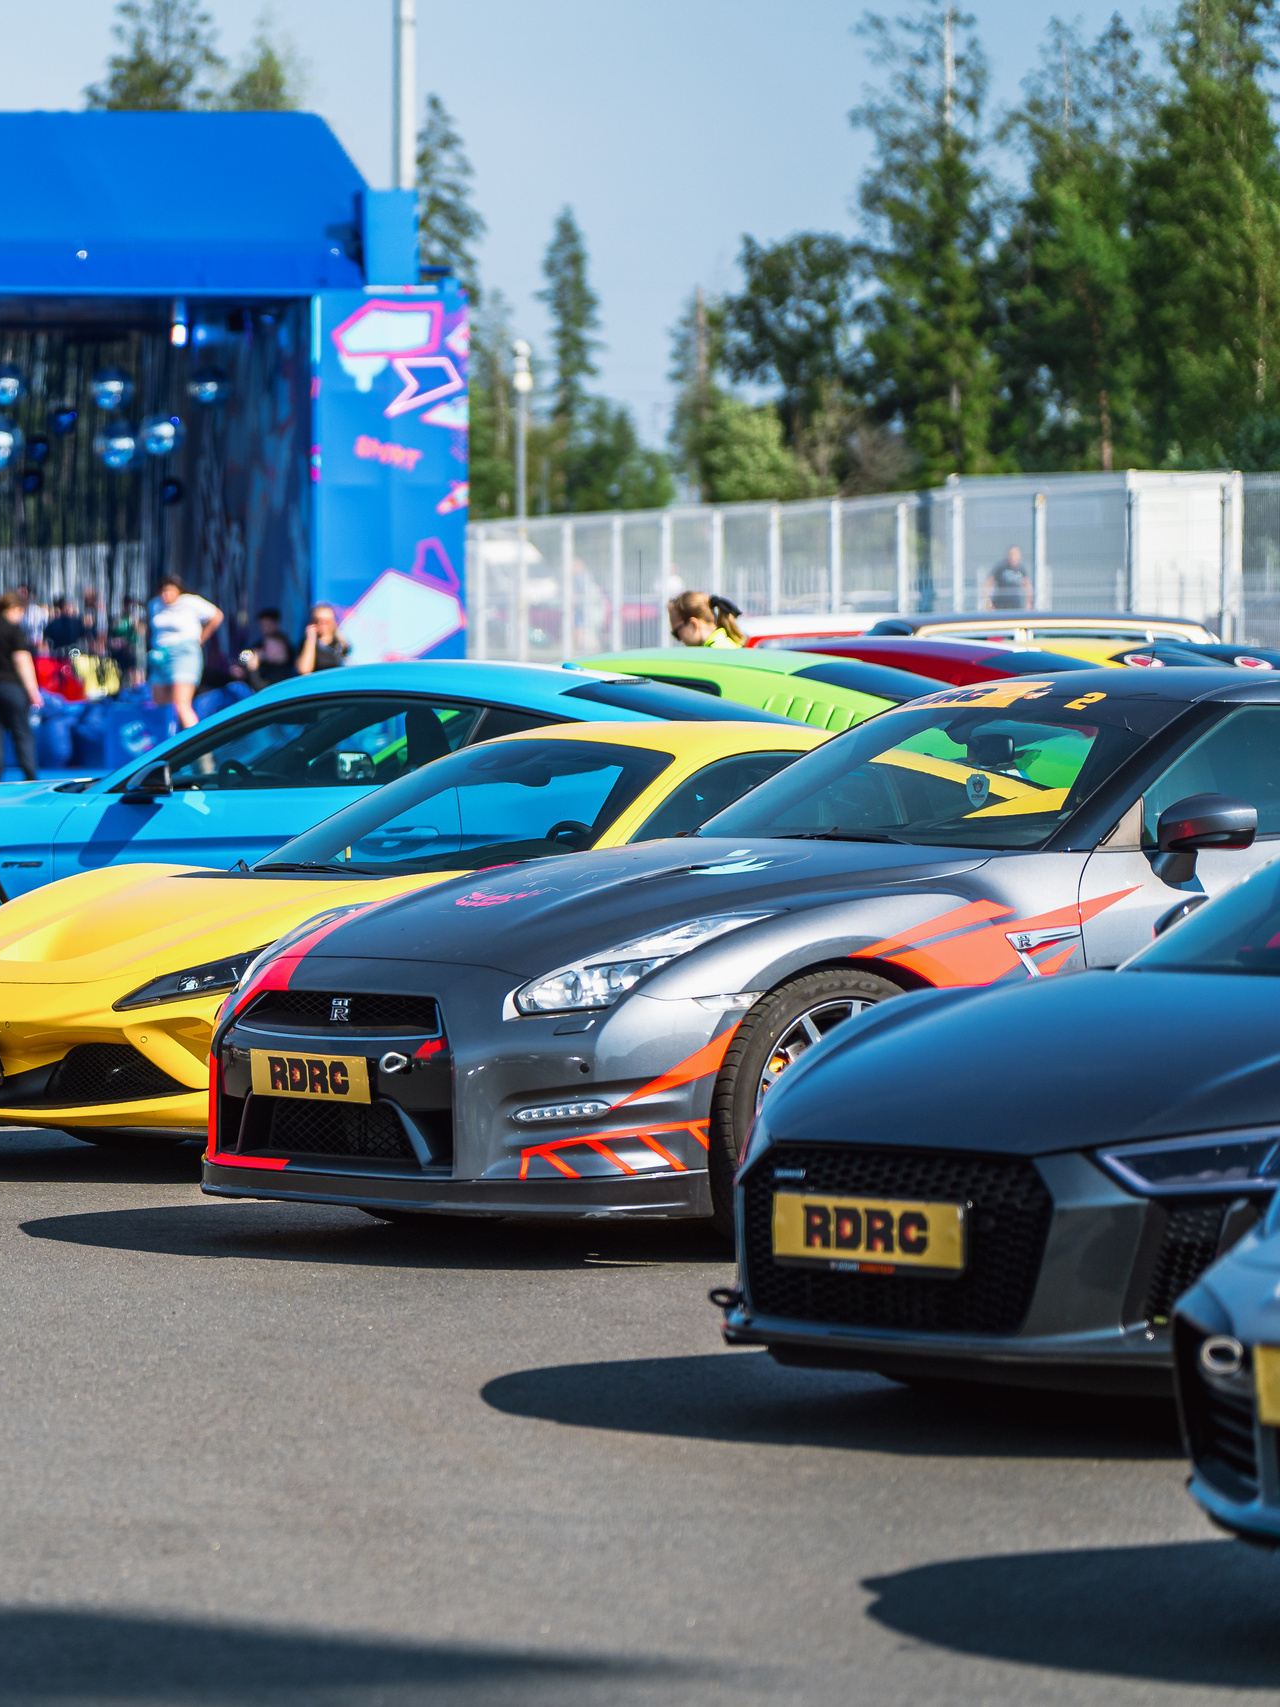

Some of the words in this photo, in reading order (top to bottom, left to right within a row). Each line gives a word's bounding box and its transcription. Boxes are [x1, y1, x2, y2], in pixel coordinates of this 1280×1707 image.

[1063, 691, 1107, 711] 2
[803, 979, 879, 1001] TOYO
[267, 1055, 351, 1096] RDRC
[801, 1203, 930, 1255] RDRC
